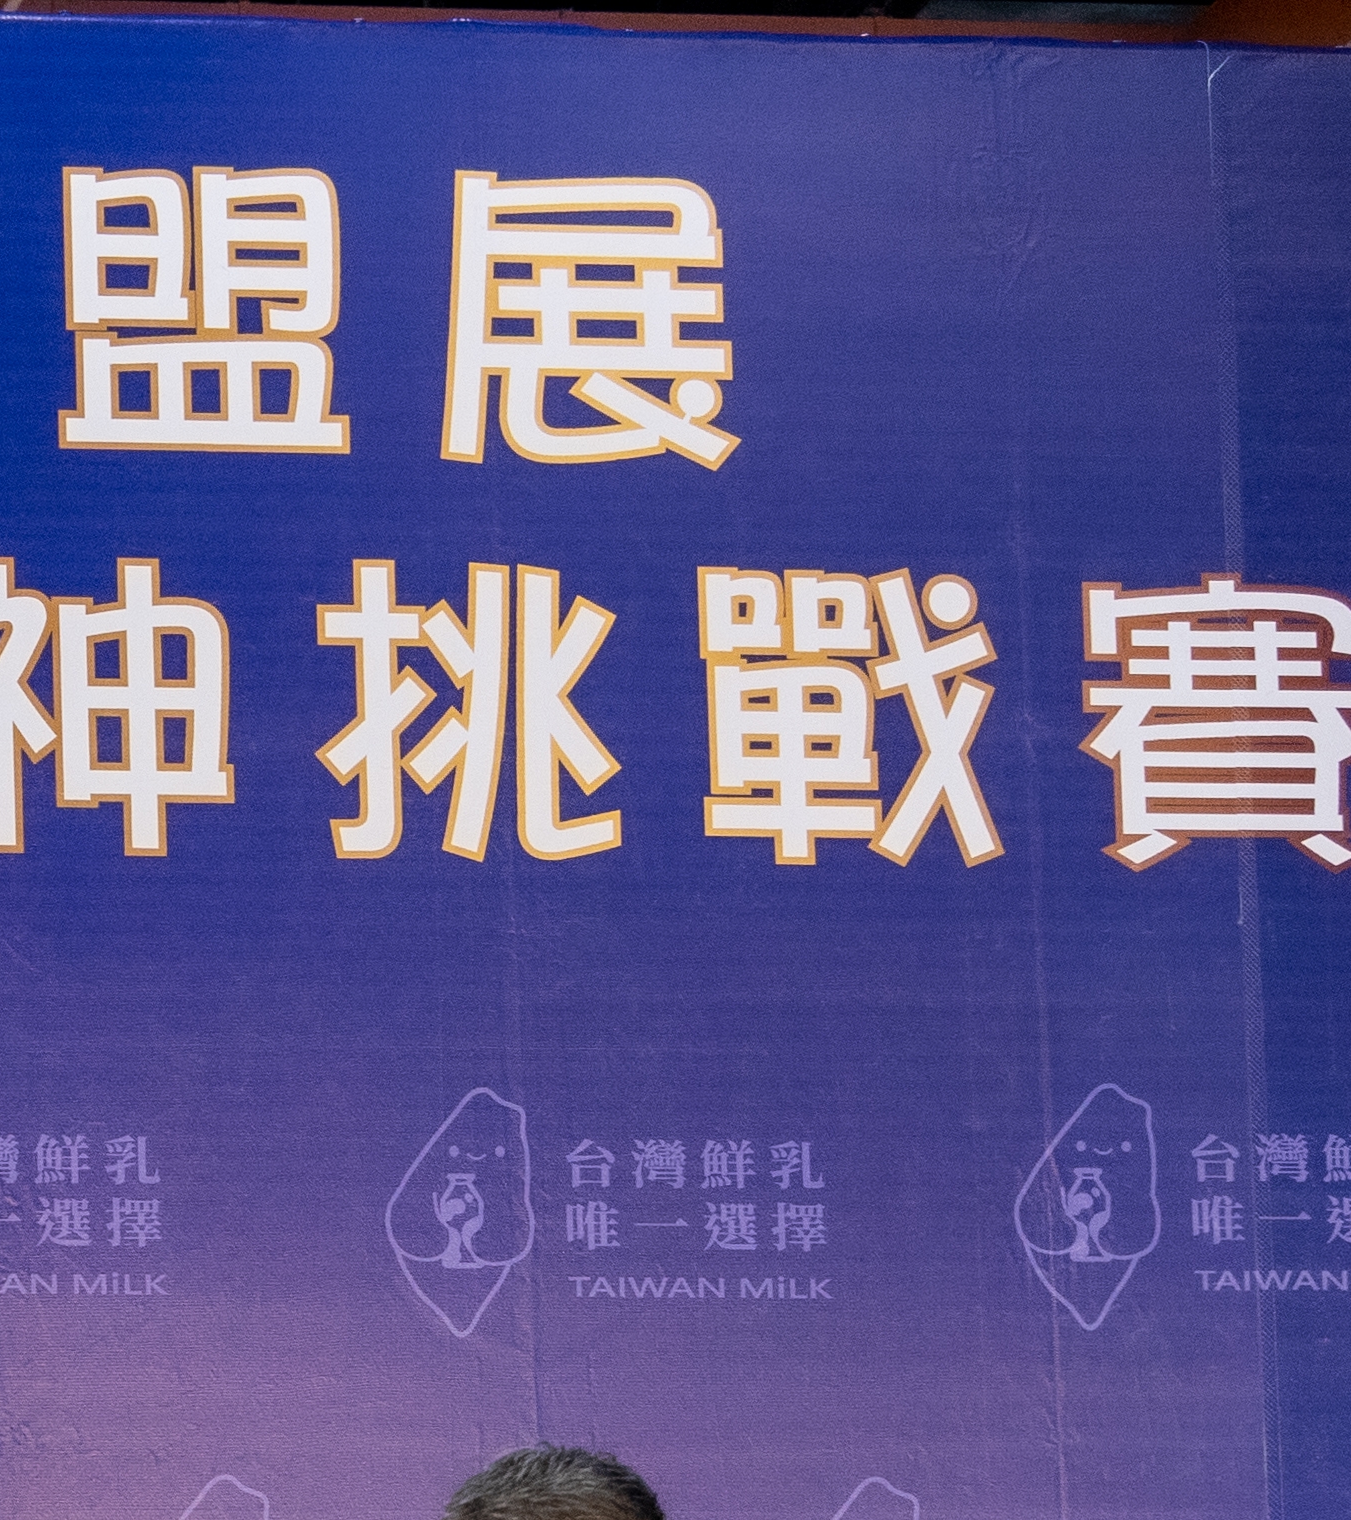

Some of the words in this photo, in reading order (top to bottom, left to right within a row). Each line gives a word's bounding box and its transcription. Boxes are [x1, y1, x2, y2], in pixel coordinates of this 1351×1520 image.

[564, 1137, 826, 1190] 台灣鮮乳
[565, 1199, 828, 1252] 唯一選擇
[72, 1271, 170, 1296] MiLK
[567, 1275, 727, 1299] TAIWAN
[739, 1273, 835, 1300] MiLK
[1193, 1269, 1350, 1292] TAIWAN
